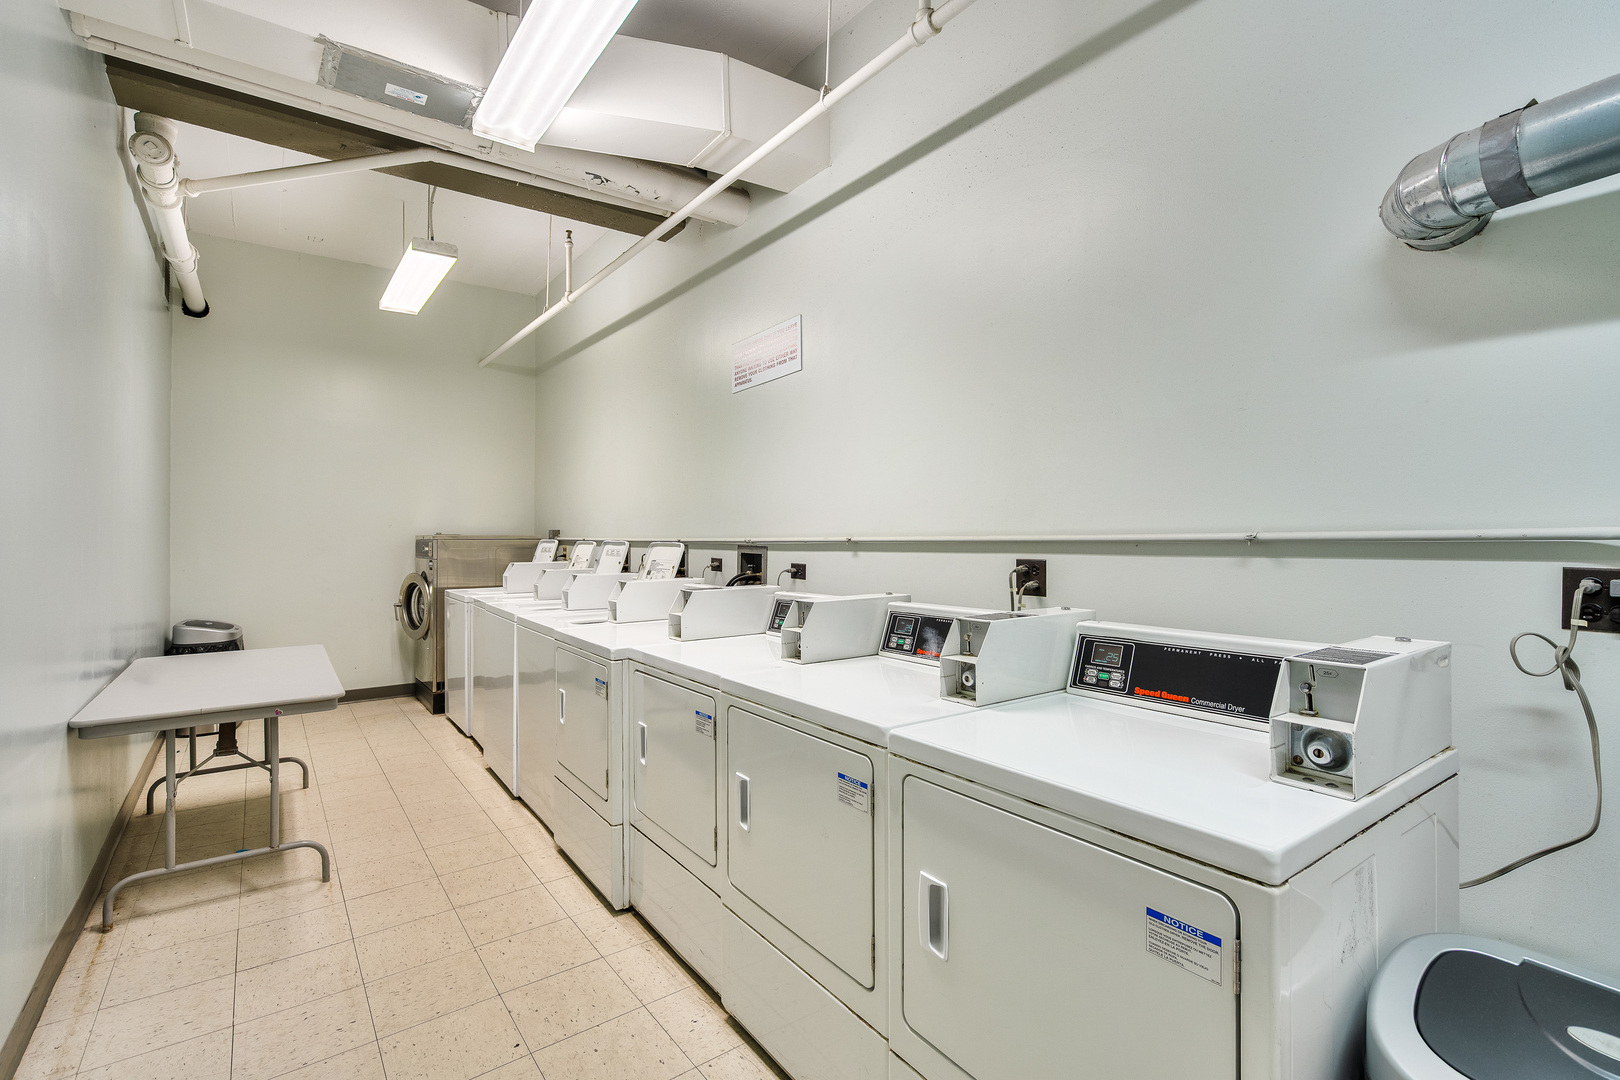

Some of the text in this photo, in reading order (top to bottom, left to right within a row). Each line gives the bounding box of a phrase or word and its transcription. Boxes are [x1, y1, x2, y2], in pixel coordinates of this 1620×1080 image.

[1164, 647, 1202, 655] PERMANENT
[1134, 687, 1245, 713] Speed Queen Commercial Dryer
[1164, 916, 1203, 938] NOTICE
[1182, 936, 1198, 946] REMOVE
